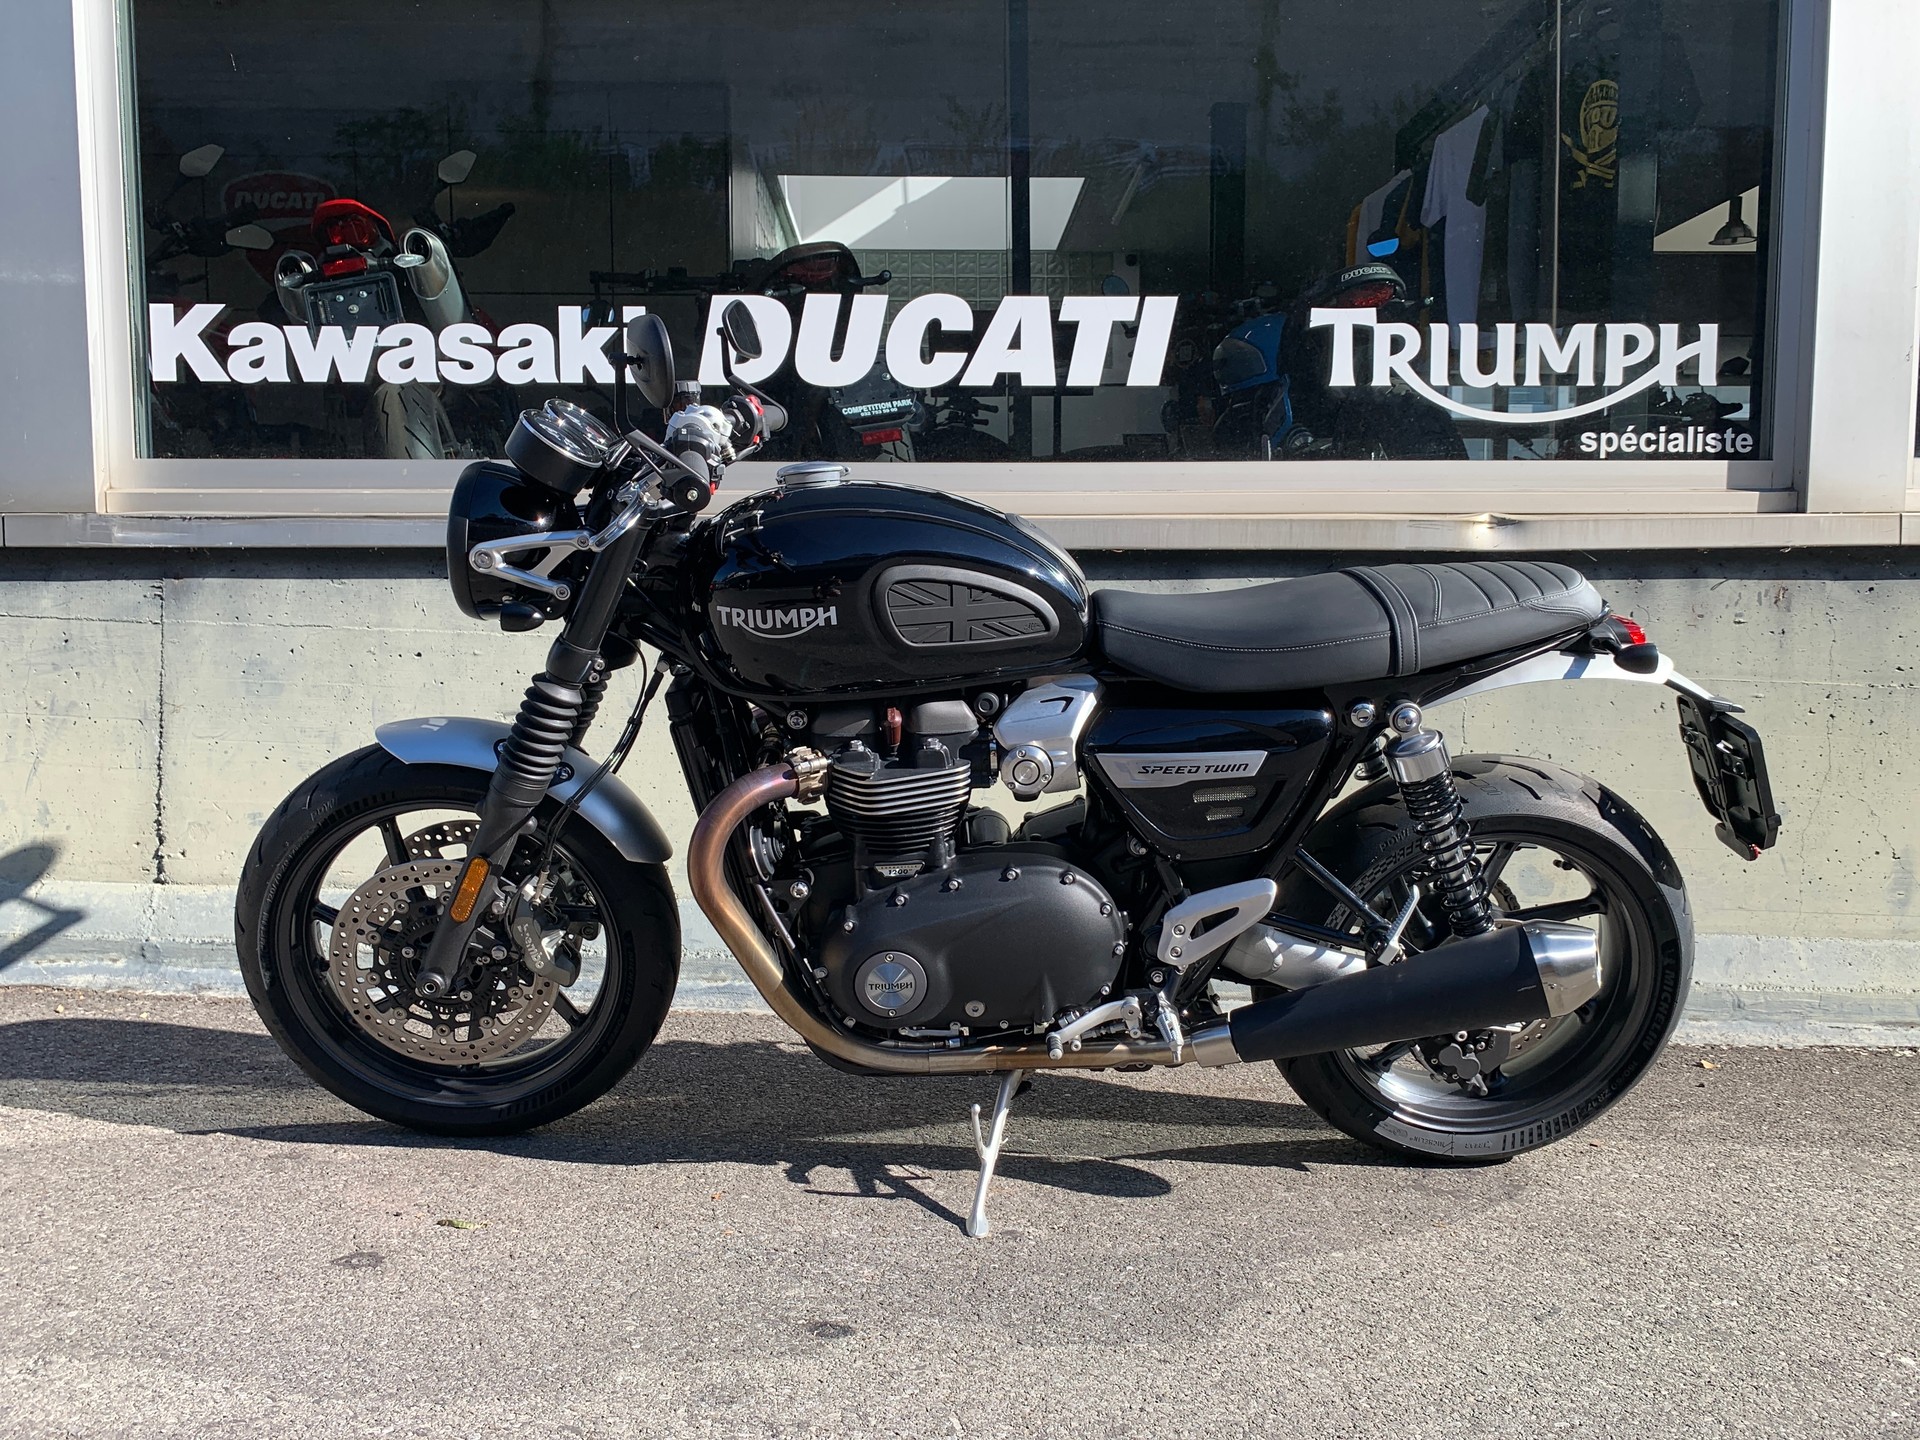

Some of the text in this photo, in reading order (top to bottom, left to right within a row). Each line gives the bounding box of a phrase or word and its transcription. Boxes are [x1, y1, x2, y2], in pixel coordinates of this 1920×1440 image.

[698, 292, 1178, 388] DUCATI
[1309, 307, 1719, 424] TRIUMPH
[842, 398, 913, 415] COMPETITION PARK
[1579, 425, 1753, 459] spécialiste
[716, 605, 838, 639] TRIUMPH
[1138, 763, 1249, 775] SPEED TWIN
[868, 981, 913, 994] TRIUMPH
[1642, 968, 1677, 1052] MICHELIN
